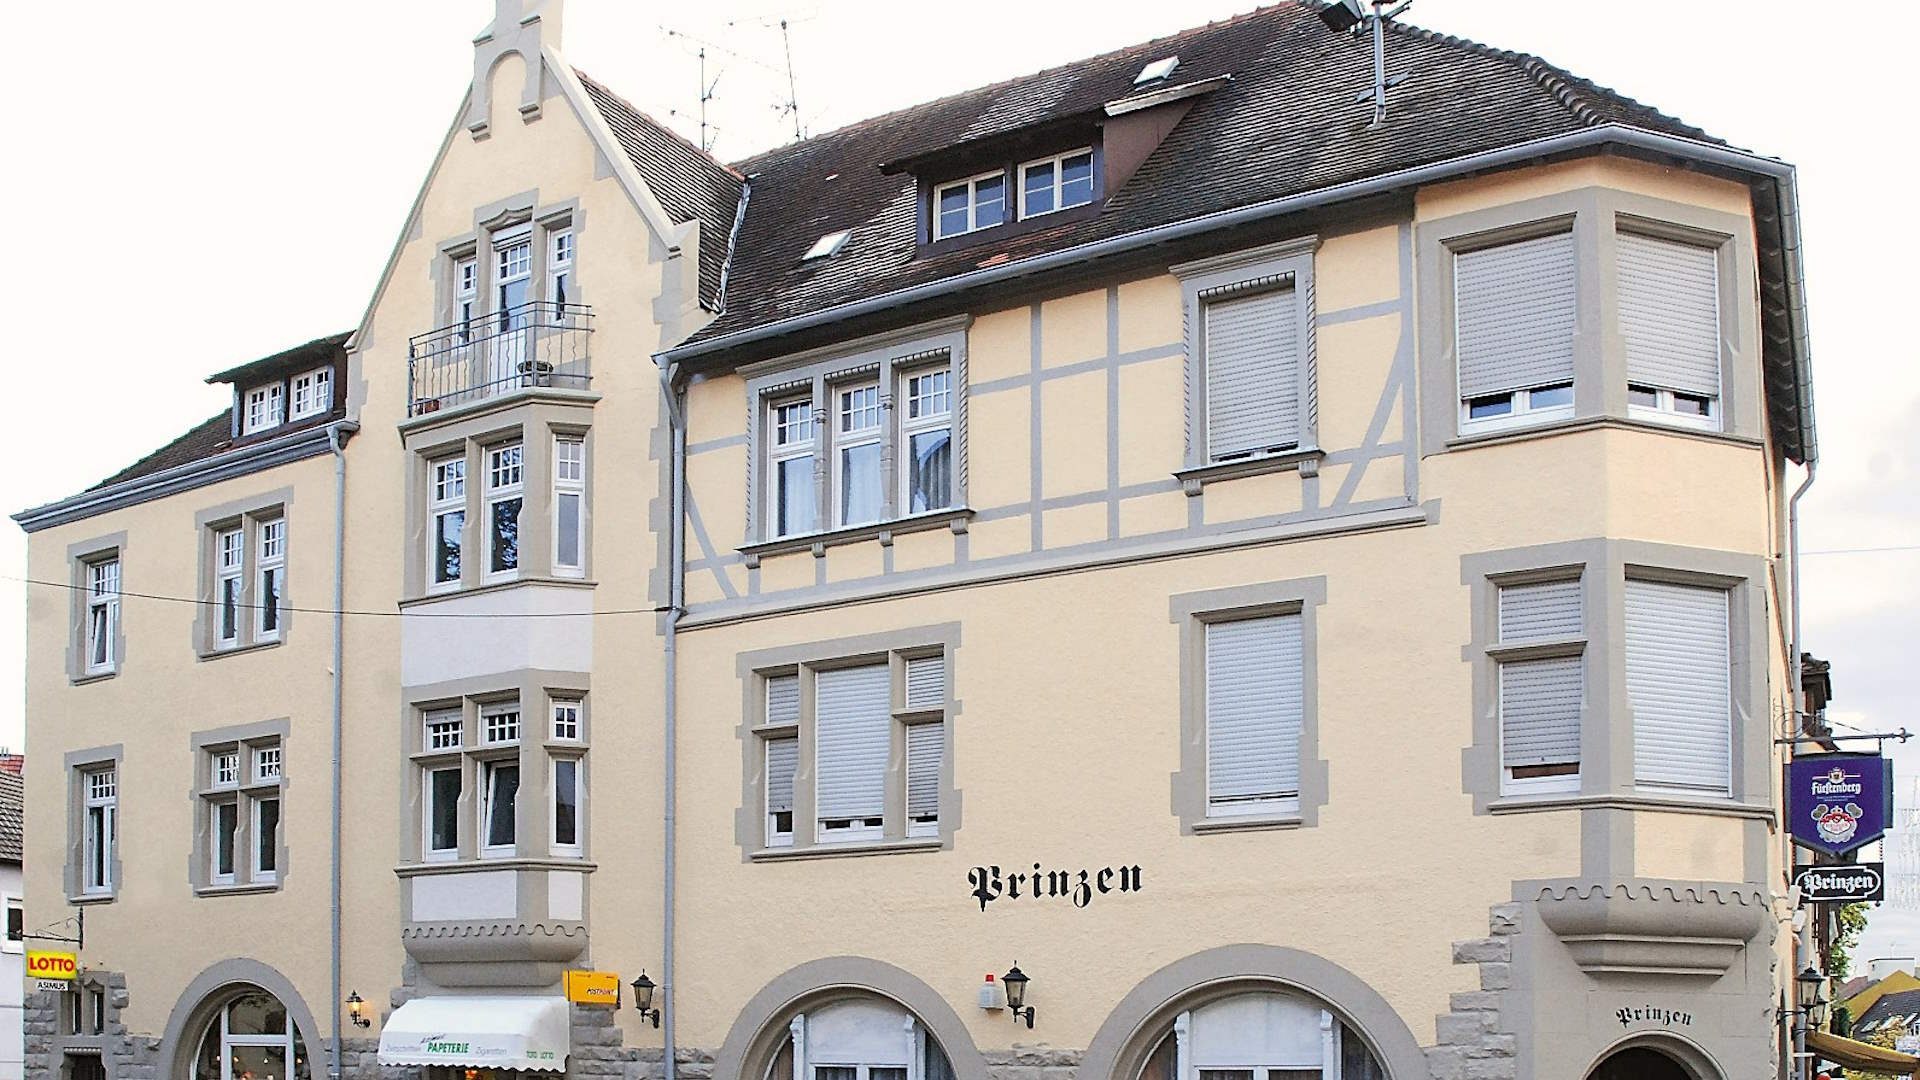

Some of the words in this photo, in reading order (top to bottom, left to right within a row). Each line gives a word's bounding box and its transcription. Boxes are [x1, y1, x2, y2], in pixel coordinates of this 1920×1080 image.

[967, 862, 1142, 912] Prinzen
[1803, 873, 1874, 895] Prinzen
[29, 957, 75, 972] LOTTO
[37, 981, 66, 990] ASIMUS
[1615, 1004, 1692, 1029] Prinzen
[427, 1042, 470, 1054] PAPETERIE
